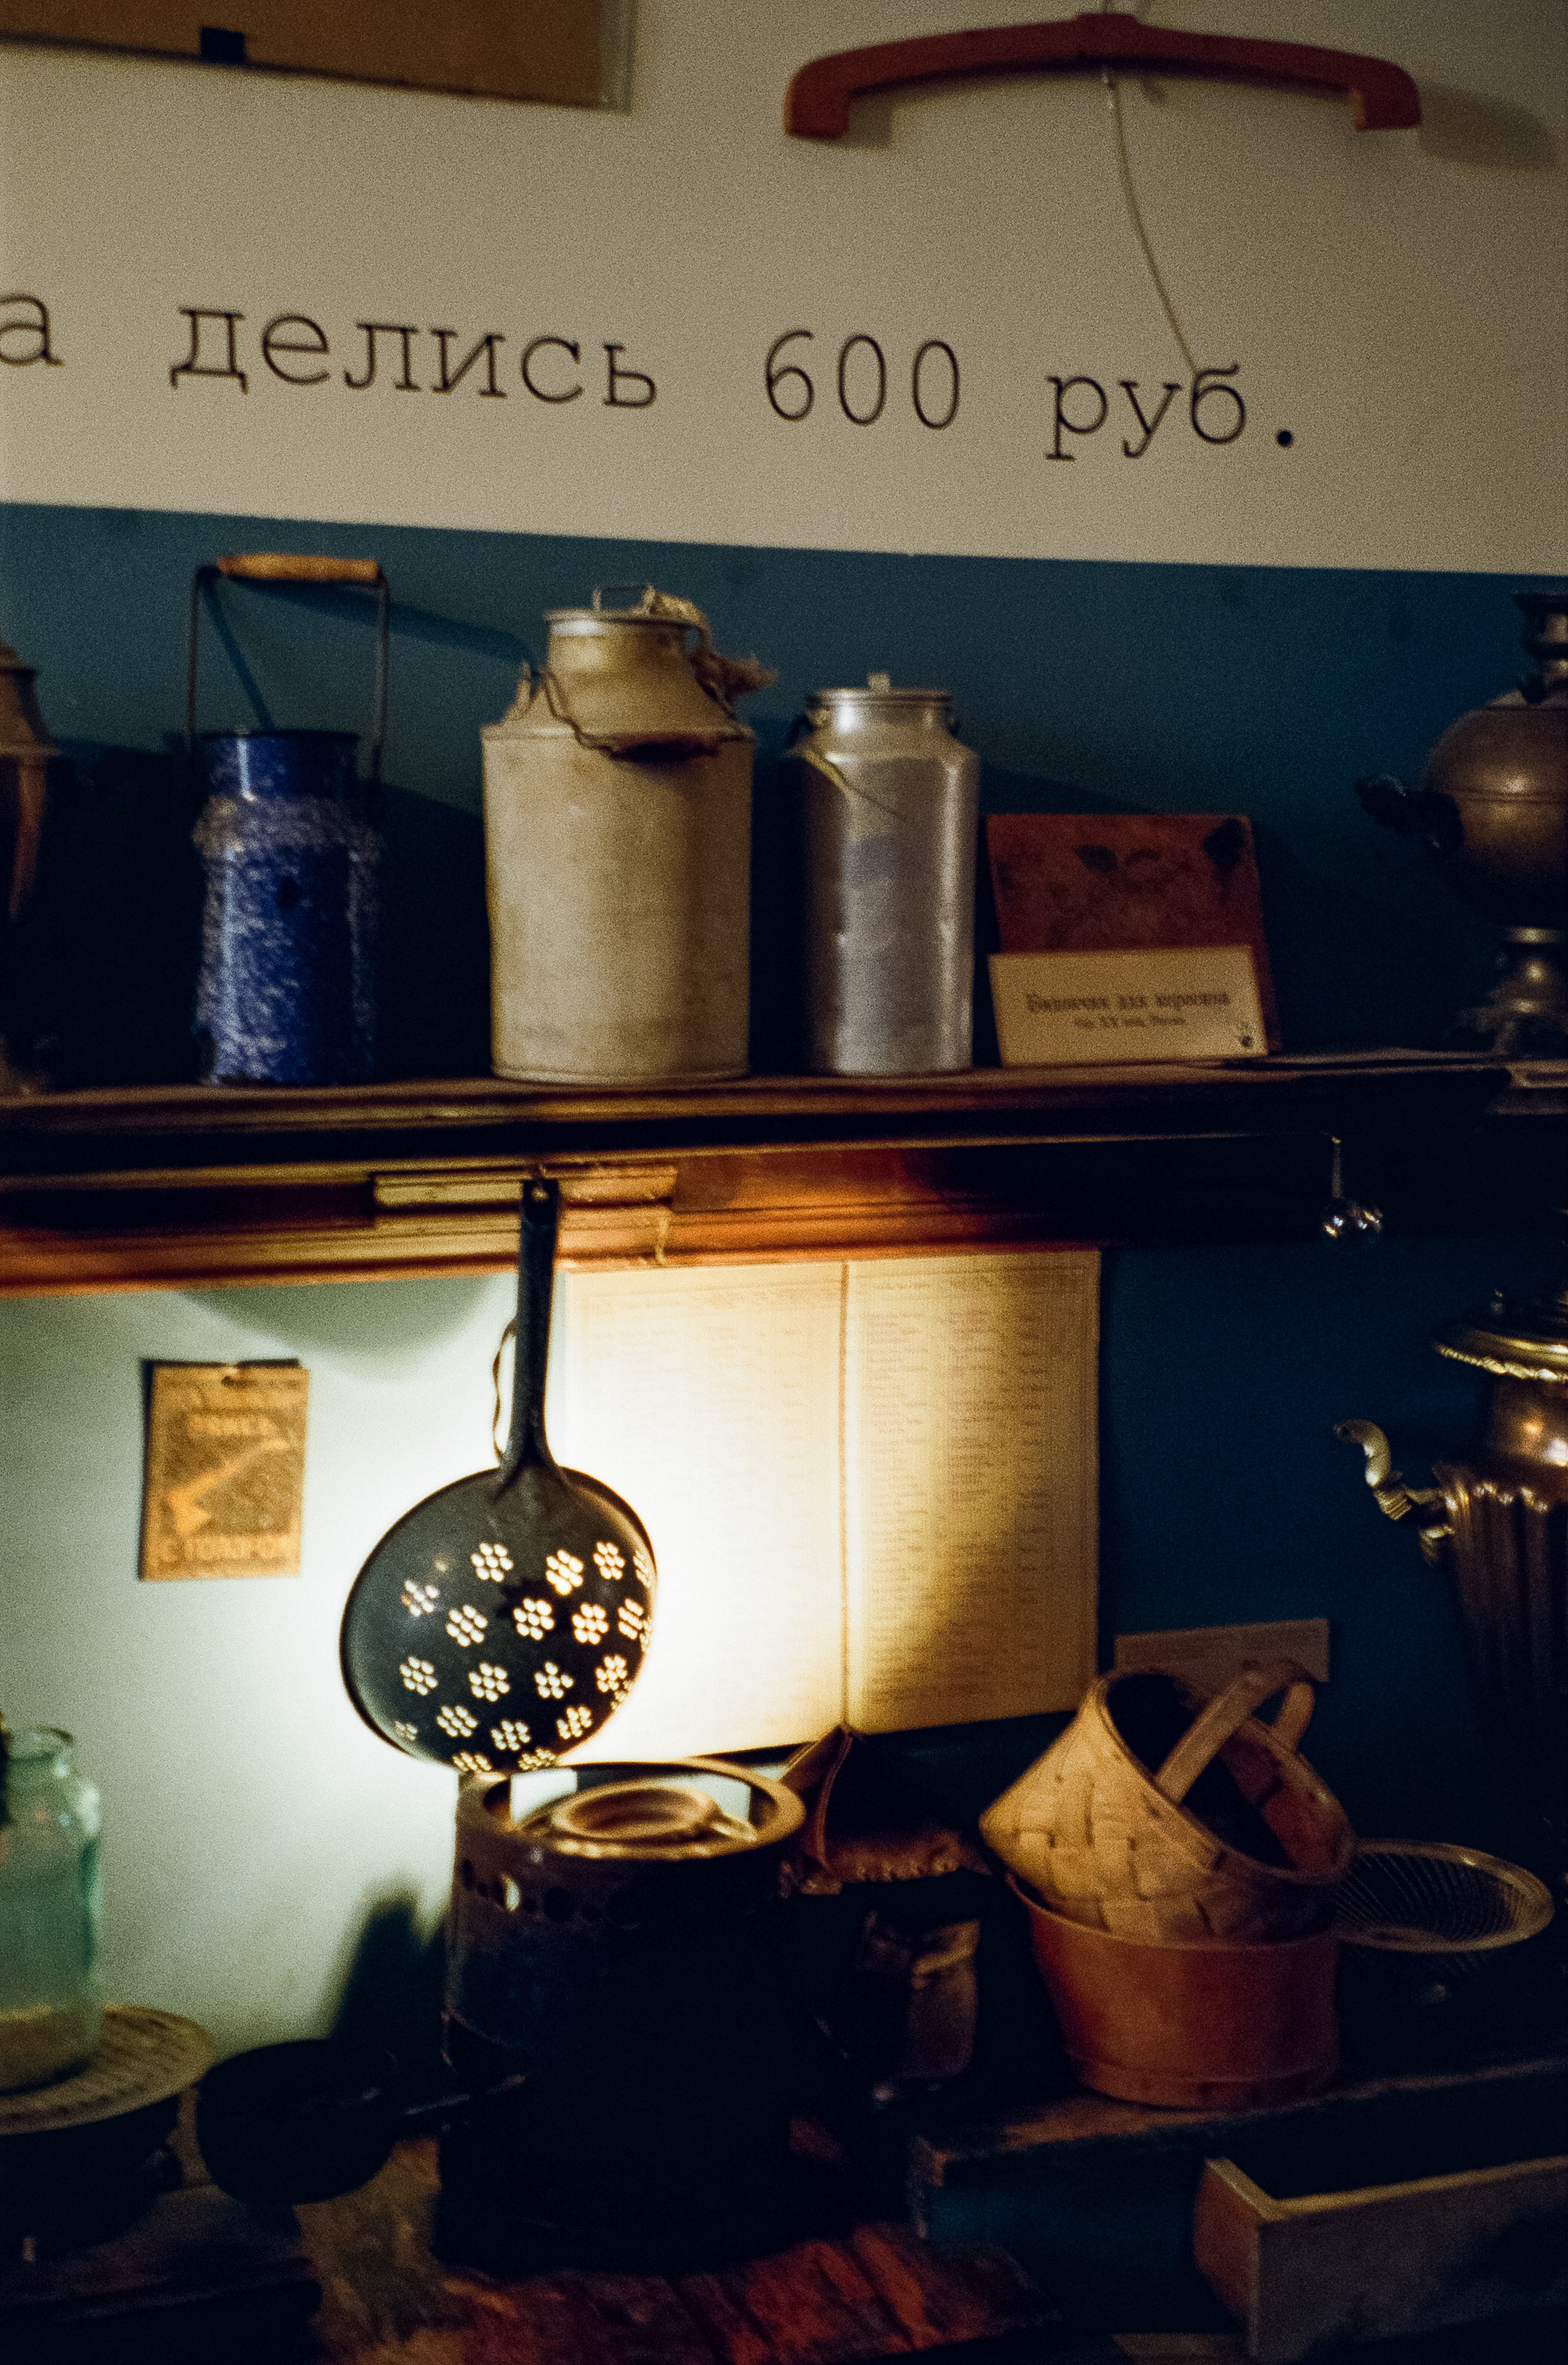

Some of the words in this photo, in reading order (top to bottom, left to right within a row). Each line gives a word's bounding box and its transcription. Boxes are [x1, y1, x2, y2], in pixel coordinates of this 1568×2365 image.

[170, 308, 656, 408] делись
[765, 329, 959, 429] 600
[1045, 363, 1294, 462] руб.
